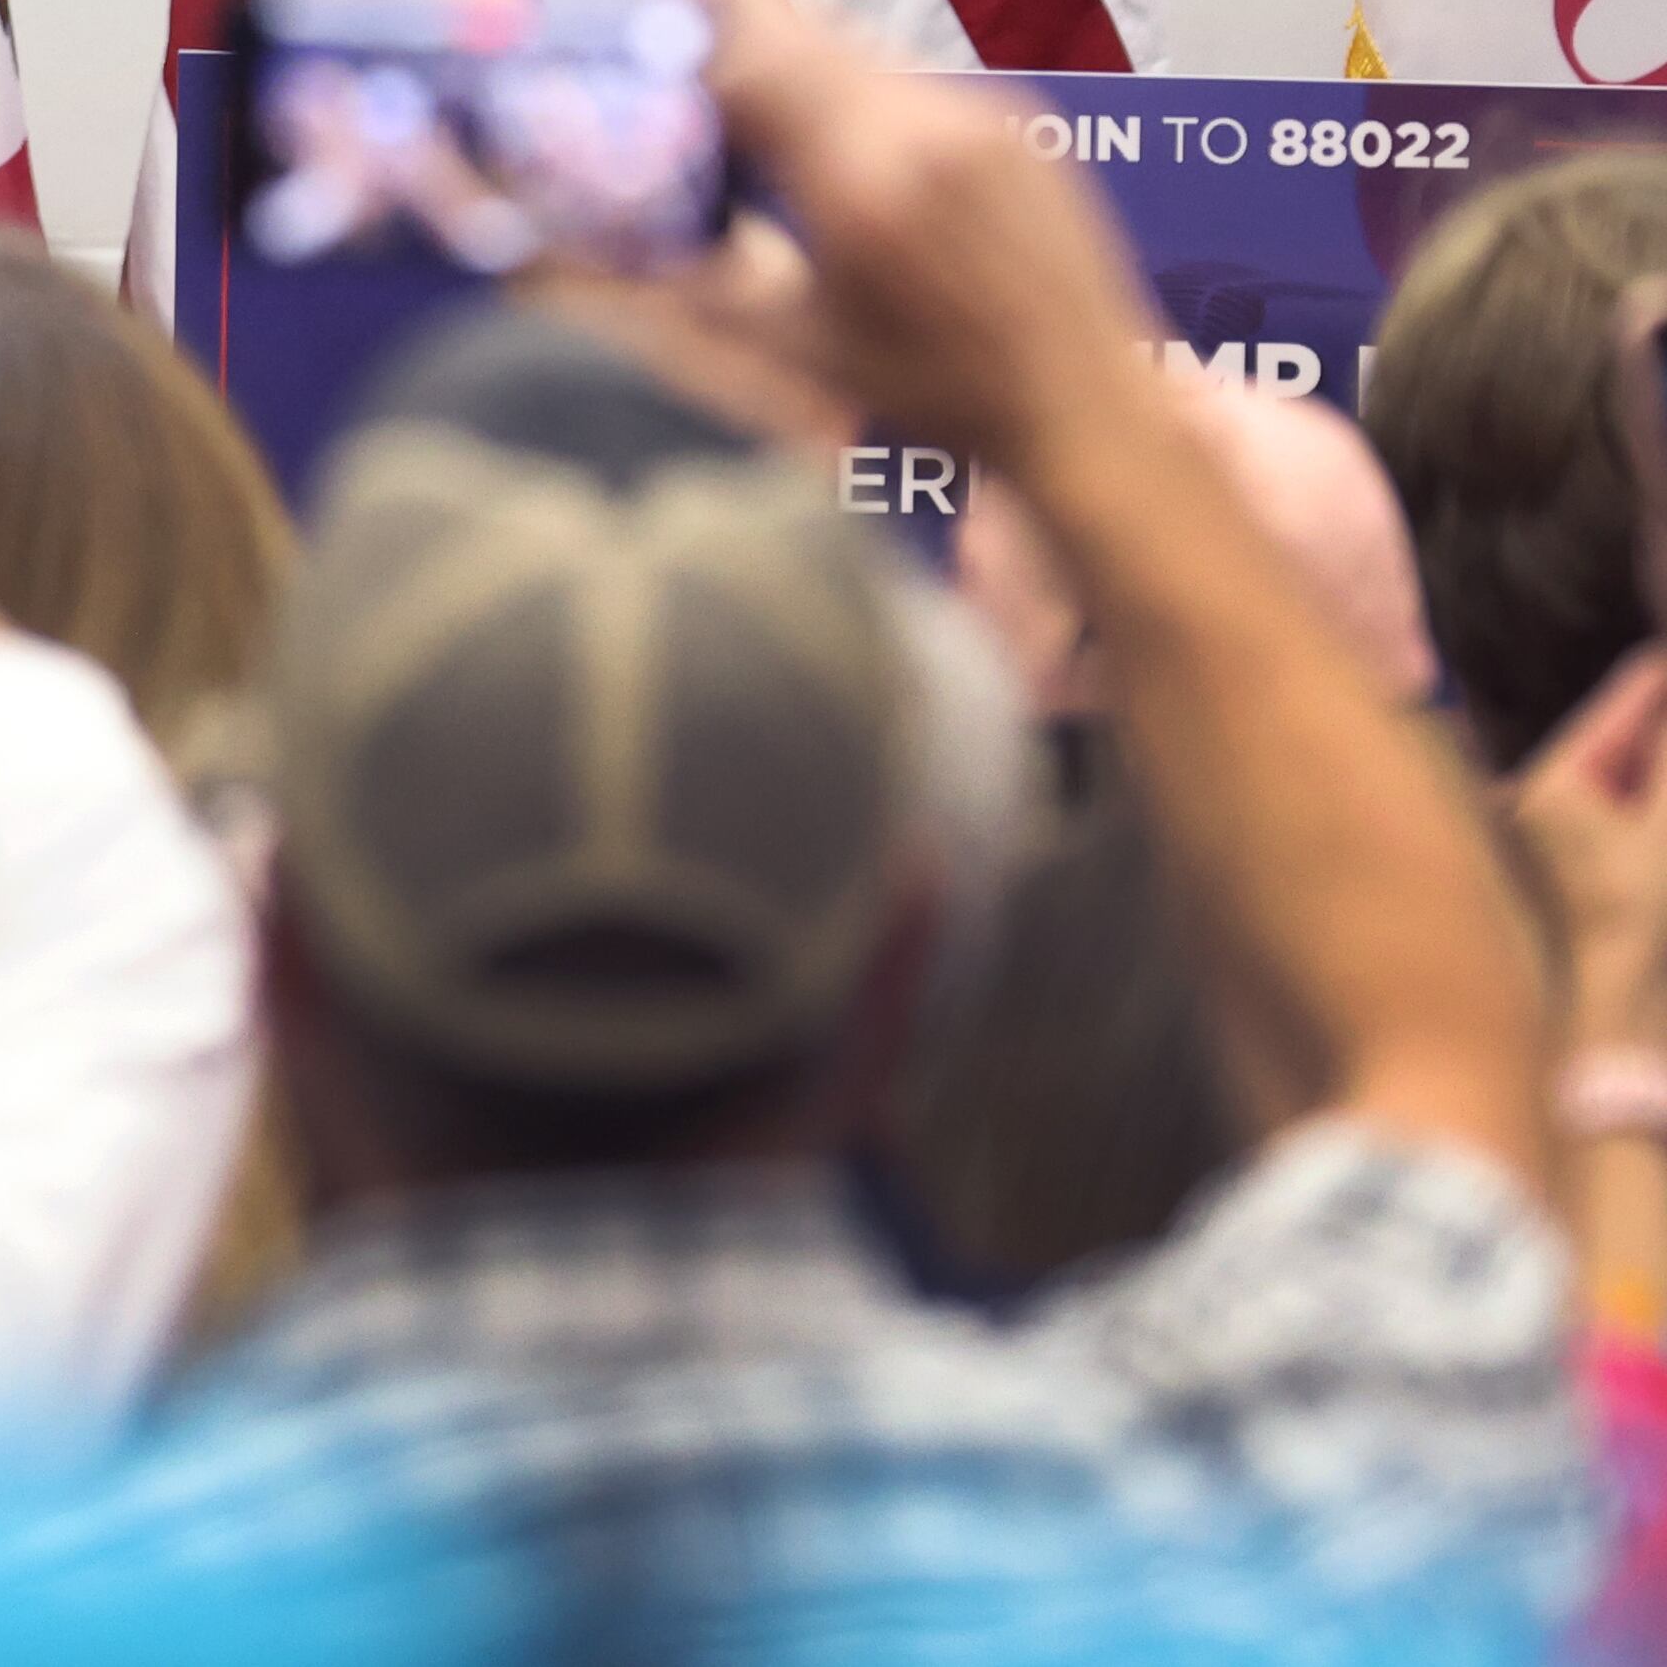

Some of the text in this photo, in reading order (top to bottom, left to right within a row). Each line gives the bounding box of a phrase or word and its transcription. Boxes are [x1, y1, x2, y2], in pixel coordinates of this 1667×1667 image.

[1005, 112, 1470, 169] OIN TO 88022
